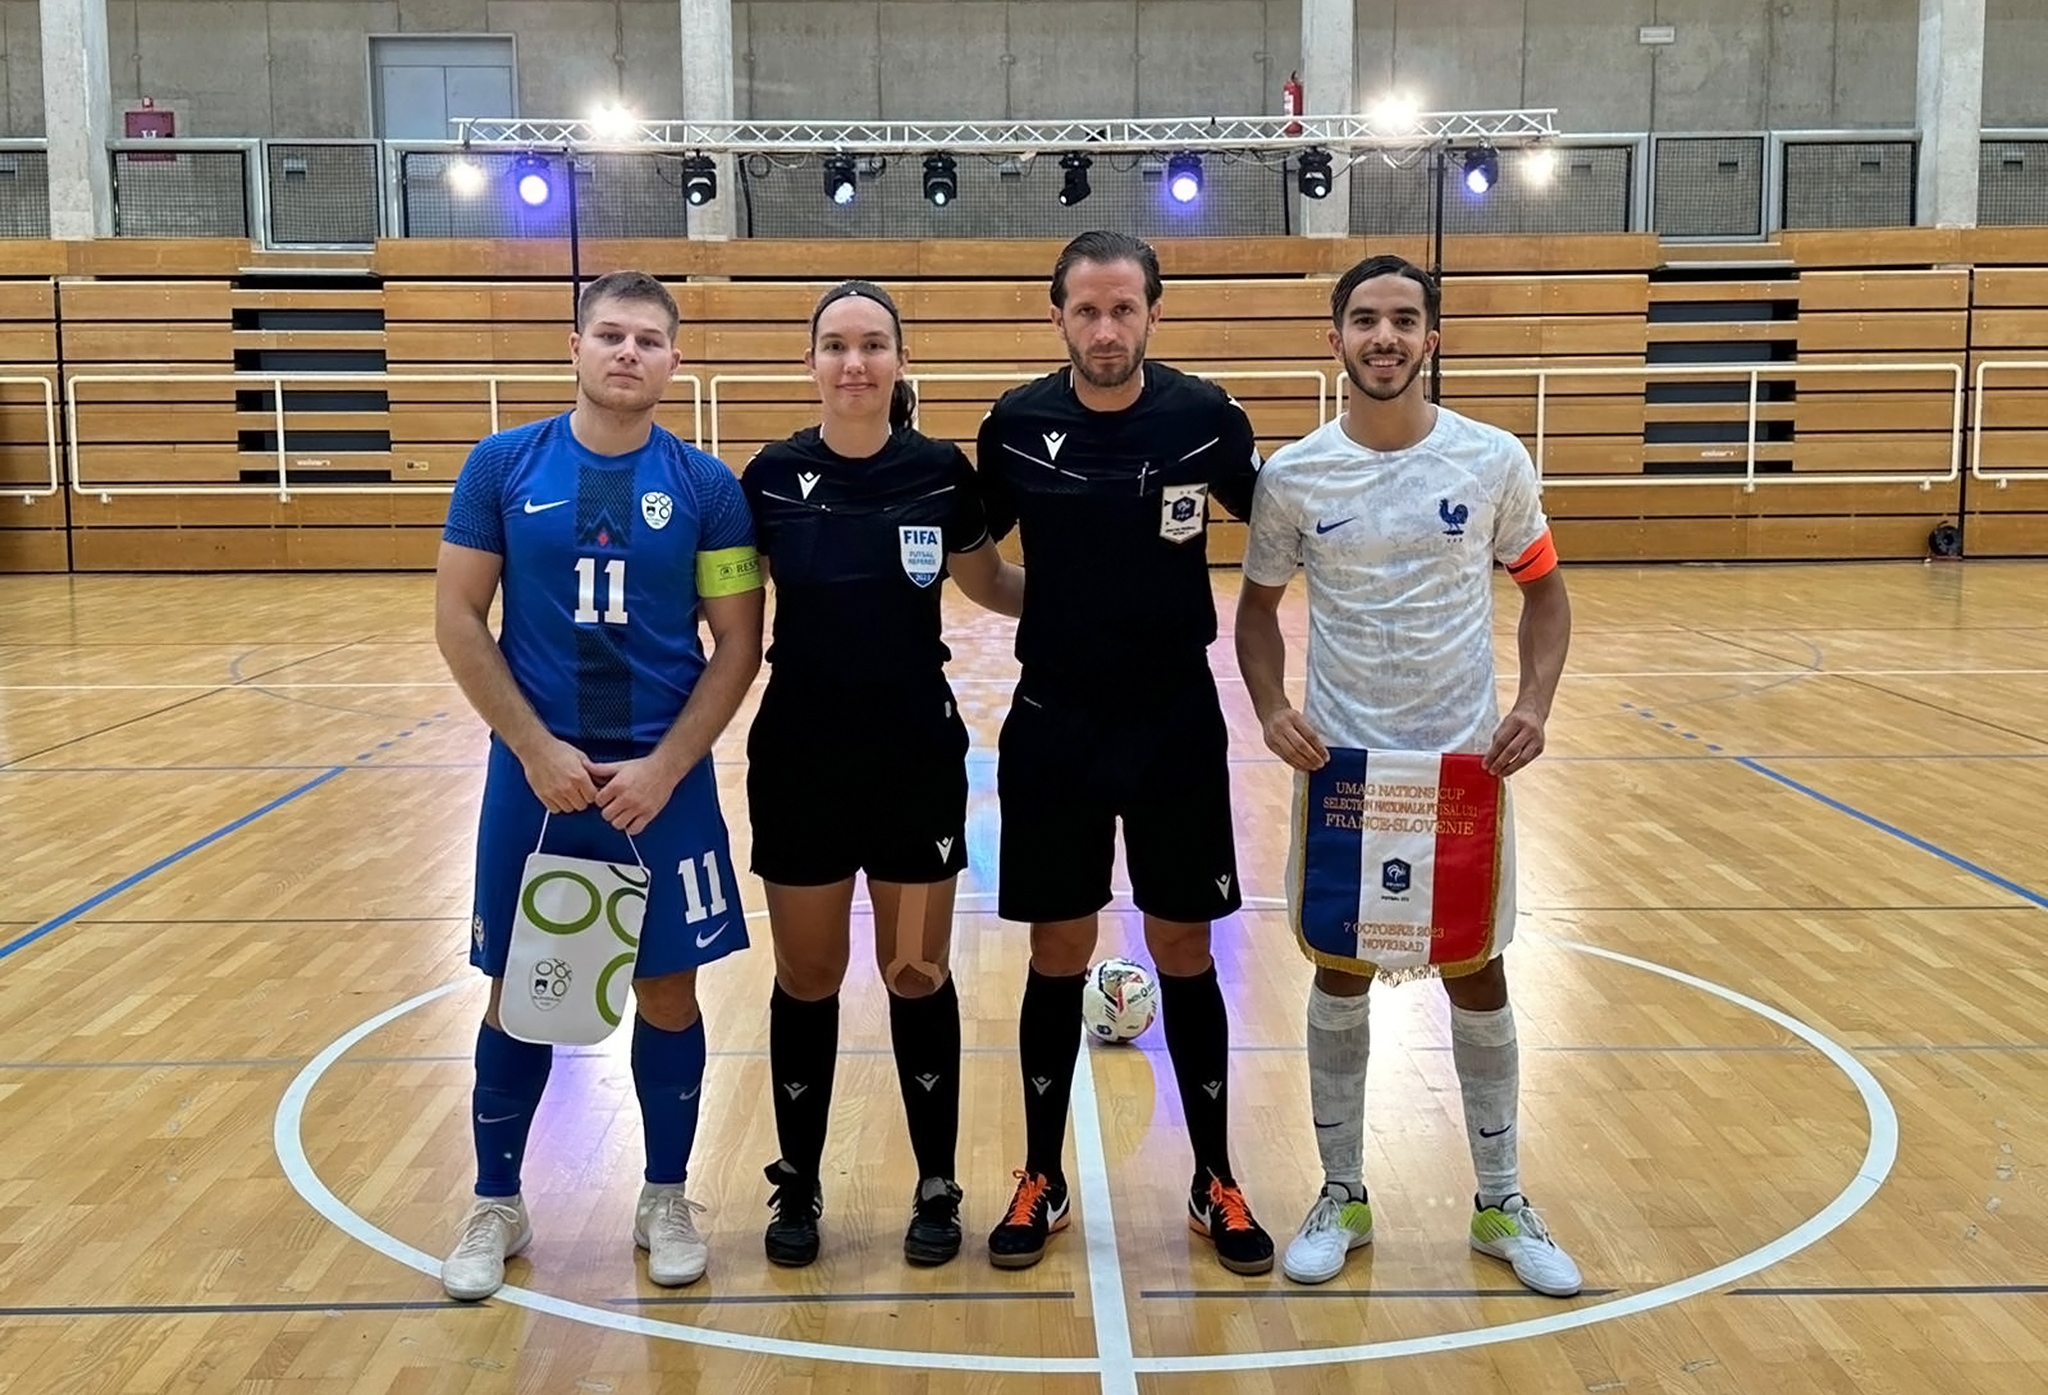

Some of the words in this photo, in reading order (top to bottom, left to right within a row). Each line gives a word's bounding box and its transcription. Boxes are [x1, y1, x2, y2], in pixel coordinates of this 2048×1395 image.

[903, 530, 938, 545] FIFA
[909, 550, 935, 558] FUTSAL
[574, 557, 628, 624] 11
[1336, 782, 1375, 796] UMAG
[1379, 784, 1436, 799] NATIONS
[1439, 787, 1465, 800] CUP
[1323, 796, 1373, 811] SELECTION
[1427, 804, 1460, 817] FUTSAL
[1325, 813, 1475, 835] FRANCE-SLOVENIE
[677, 850, 727, 925] 11
[1343, 922, 1351, 933] 7
[1353, 922, 1414, 937] OCTOBRE
[1416, 926, 1445, 939] 2023
[1362, 938, 1425, 953] NOVIGRAD
